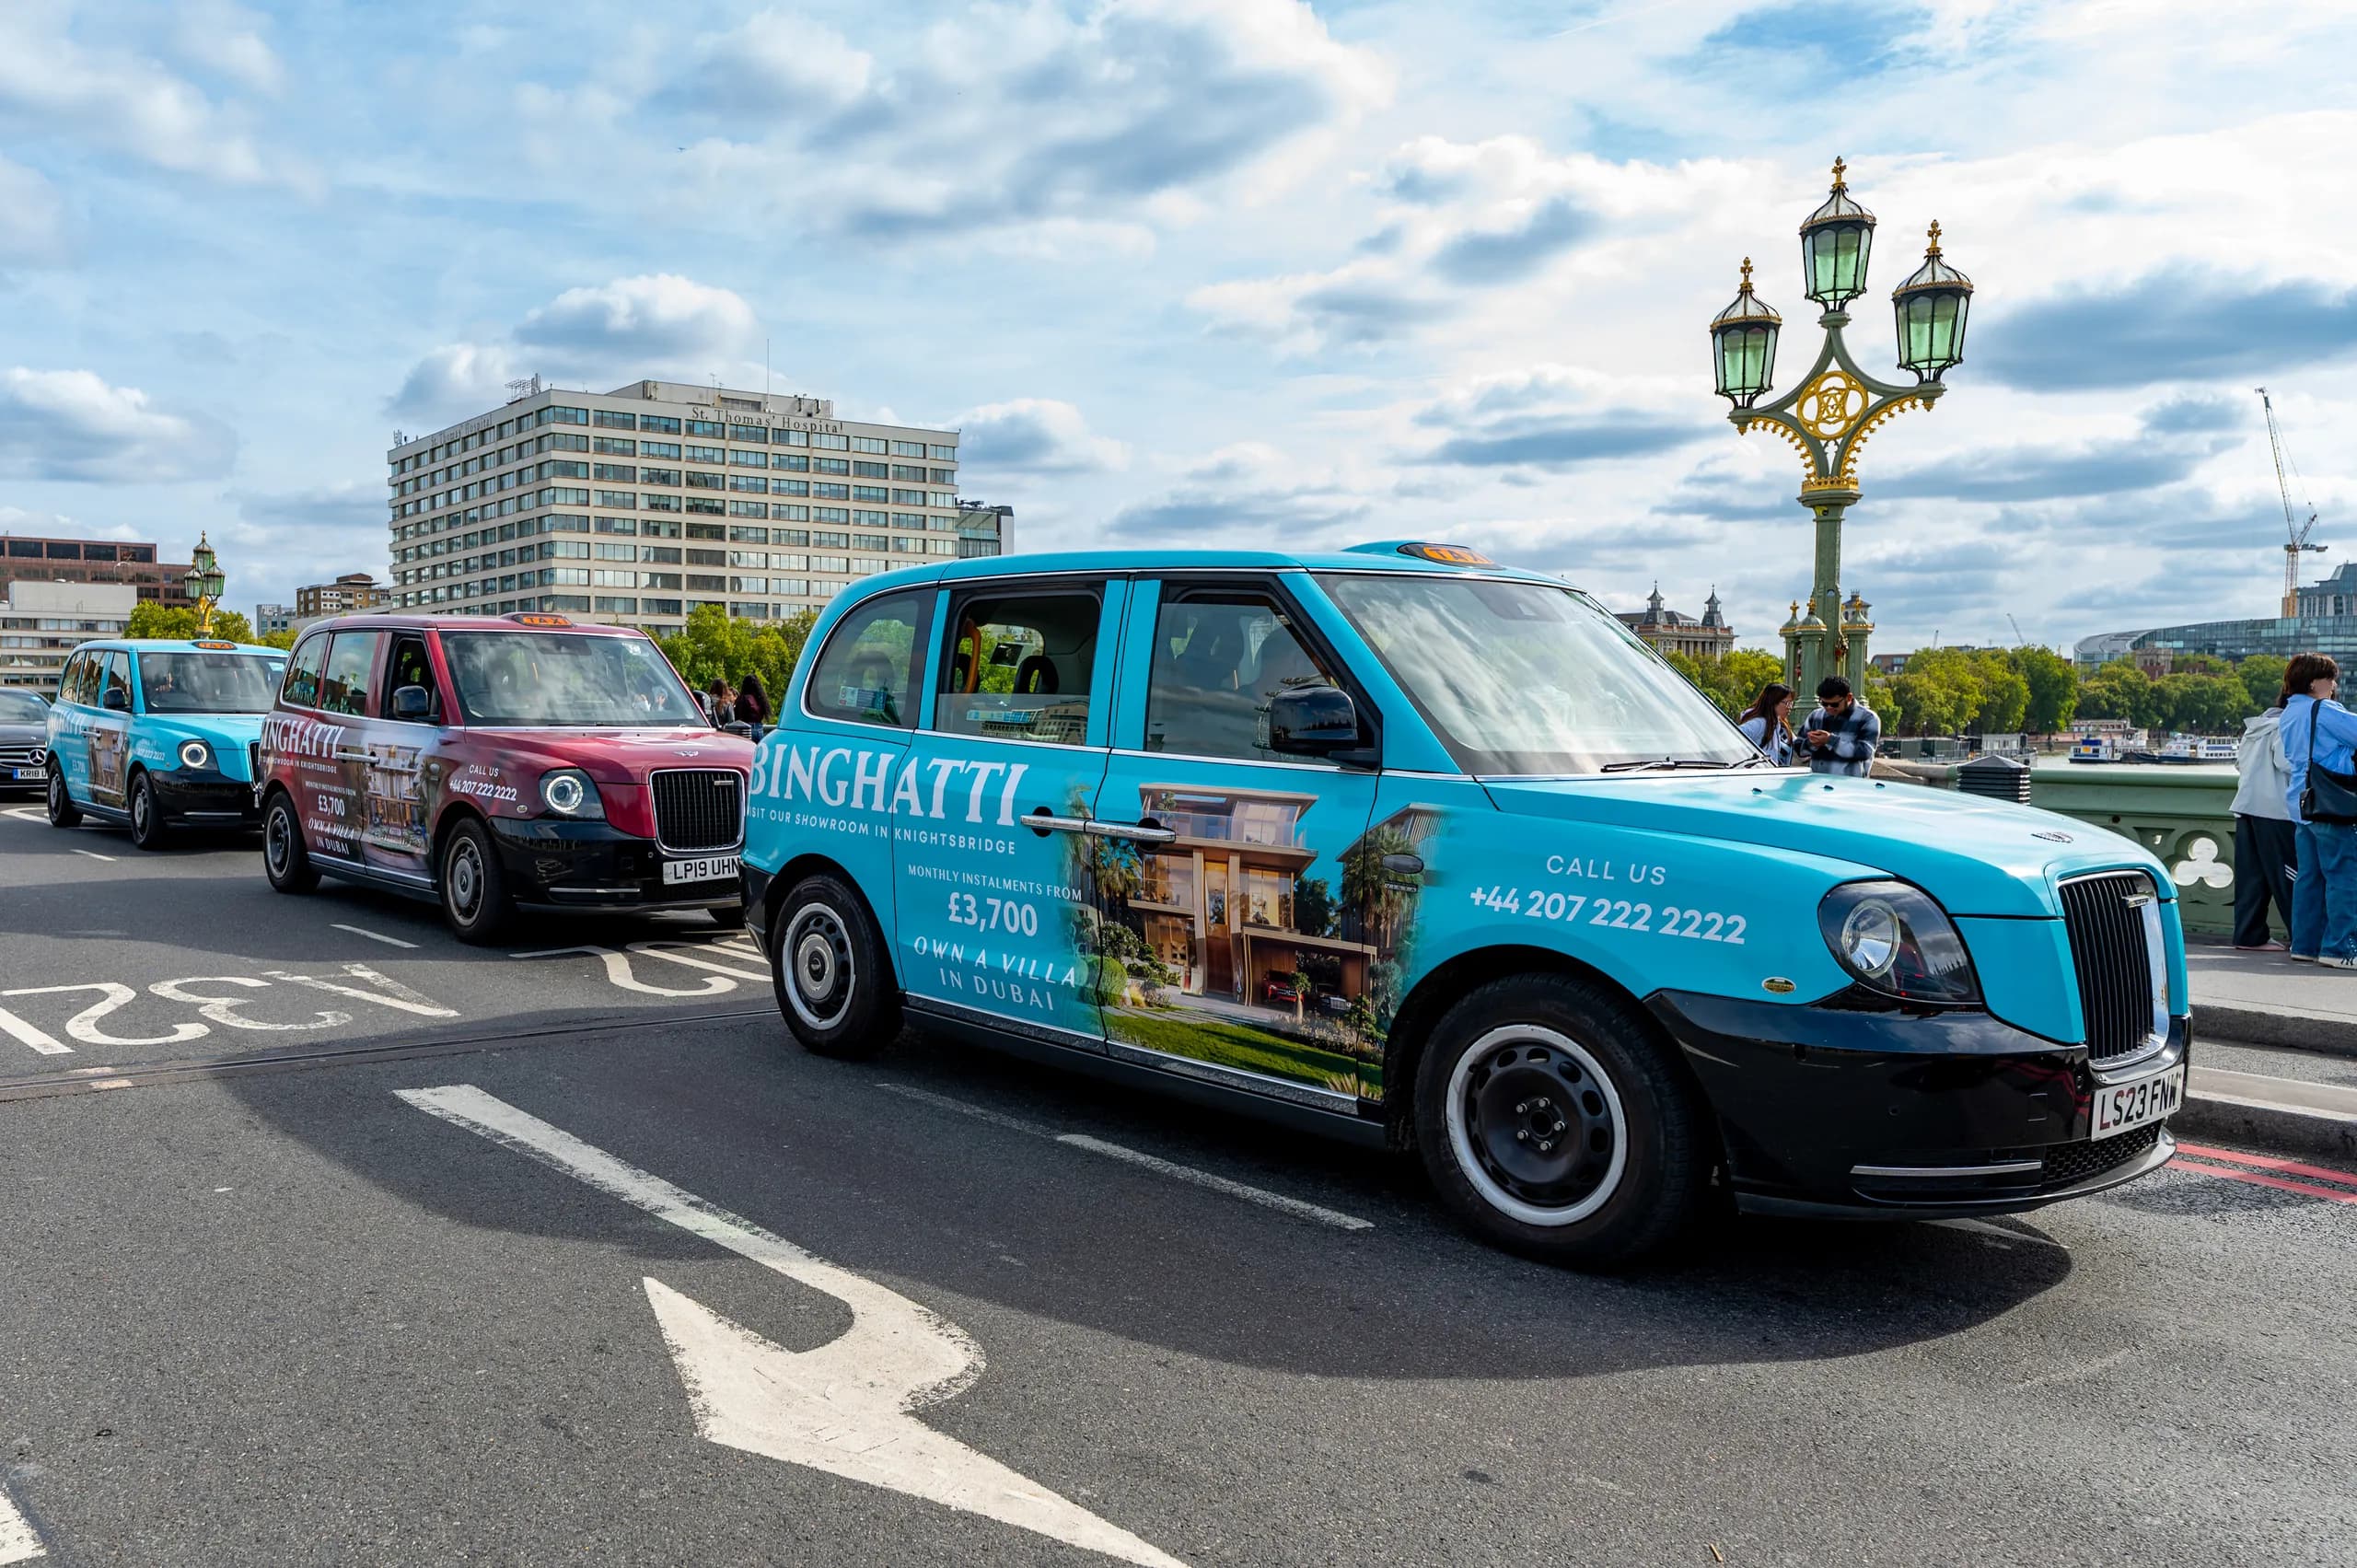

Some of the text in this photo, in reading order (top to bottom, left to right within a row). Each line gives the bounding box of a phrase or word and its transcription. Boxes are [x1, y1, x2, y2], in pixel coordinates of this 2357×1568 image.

[692, 407, 708, 420] St.
[783, 417, 843, 434] Hospital
[525, 617, 568, 625] TAXI
[261, 718, 346, 760] INGHATTI
[20, 770, 40, 778] KR18
[469, 764, 499, 777] CALL US
[749, 742, 1029, 827] BINGHATTI
[318, 794, 345, 817] £3,700
[460, 780, 478, 794] 207
[476, 783, 494, 797] 222
[493, 785, 517, 802] 2222
[308, 817, 354, 840] OWN A VILLA
[770, 809, 792, 824] OUR
[795, 813, 869, 836] SHOWROOM
[875, 823, 888, 838] IN
[894, 827, 1016, 855] KNIGHTSBRIDGE
[316, 835, 350, 855] IN DUBAI
[674, 862, 707, 880] LP19
[908, 864, 1083, 902] MONTHLY INSTALMENTS FROM
[1546, 854, 1666, 886] CALL US
[948, 891, 1039, 937] £3,700
[1469, 885, 1747, 945] +44 207 222 2222
[913, 935, 1075, 988] OWN A VILLA
[940, 968, 1054, 1011] IN DUBAI
[2099, 1084, 2148, 1132] LS23
